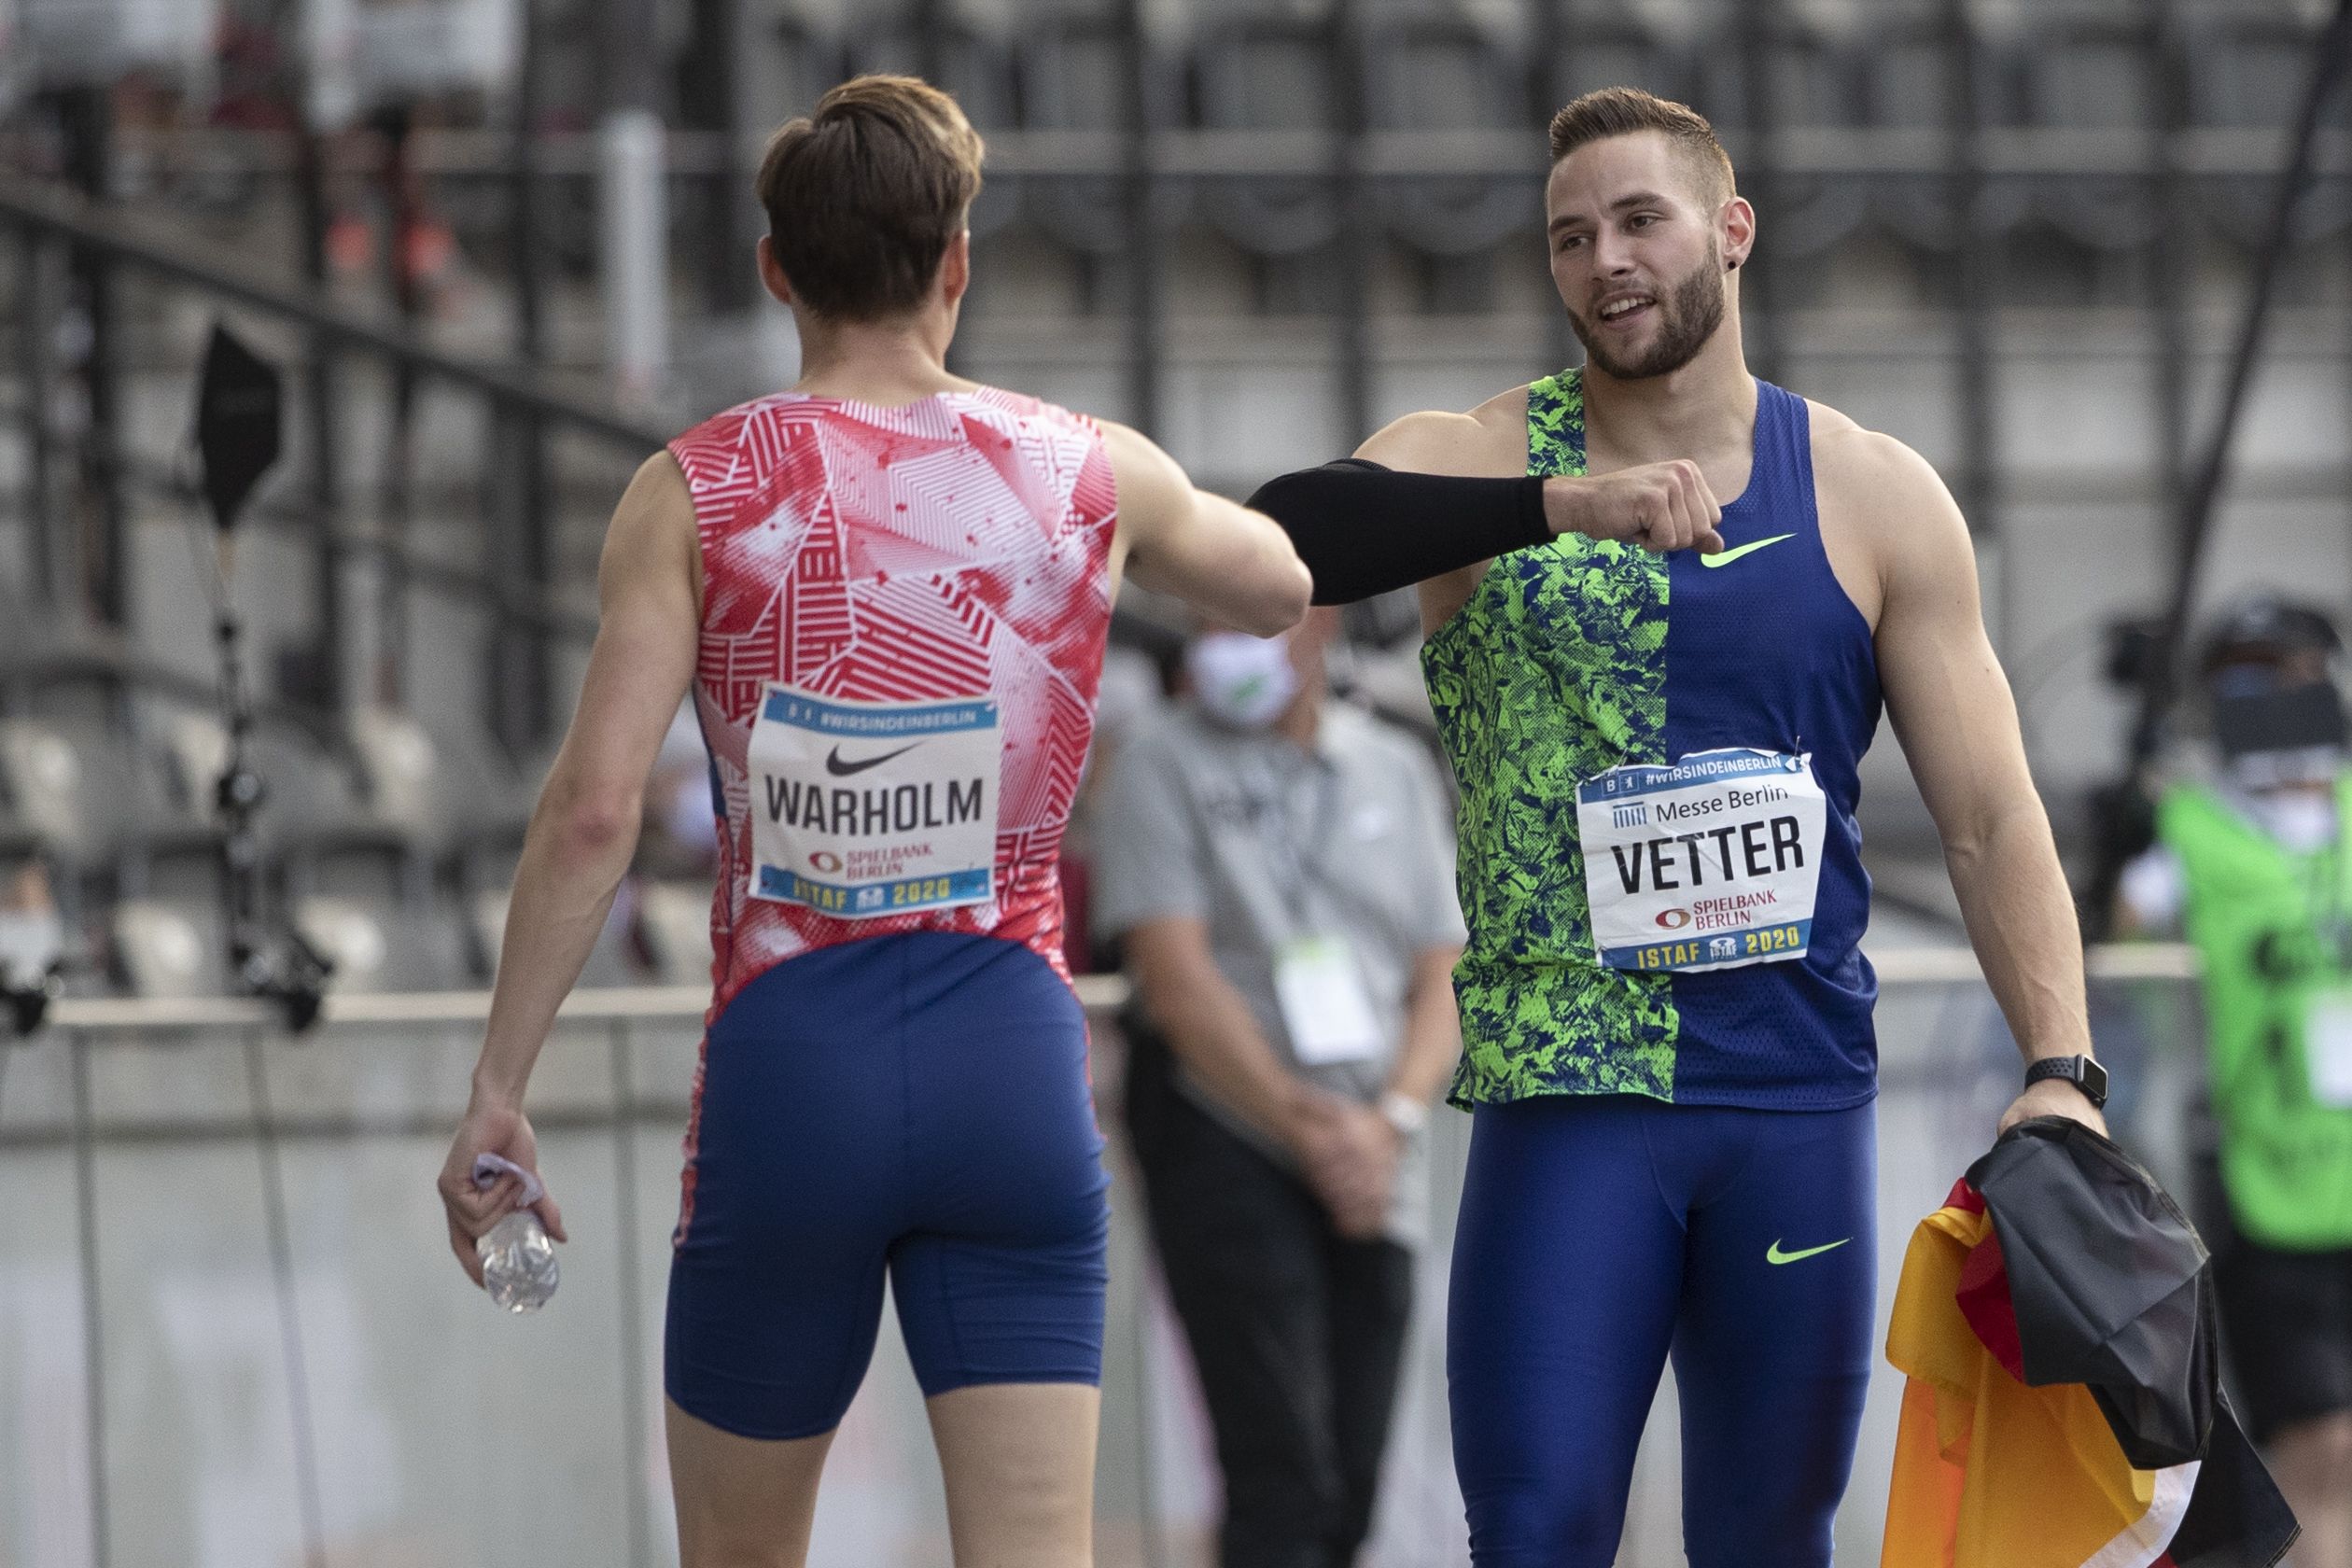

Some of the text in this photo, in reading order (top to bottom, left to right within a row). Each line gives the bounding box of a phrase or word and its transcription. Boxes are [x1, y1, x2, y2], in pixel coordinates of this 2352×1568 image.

[1645, 756, 1782, 785] #WIRSINDEINBERLIN
[765, 775, 983, 835] WARHOLM
[1656, 785, 1788, 822] Messe Berlin
[847, 843, 933, 862] SPIELBANK
[1611, 815, 1804, 895] VETTER
[847, 862, 903, 878] BERLIN
[793, 877, 950, 910] ISTAF 2020
[1693, 889, 1777, 915] SPIELBANK
[1696, 910, 1751, 931] BERLIN
[1638, 943, 1701, 969] ISTAF
[1746, 926, 1799, 953] 2020
